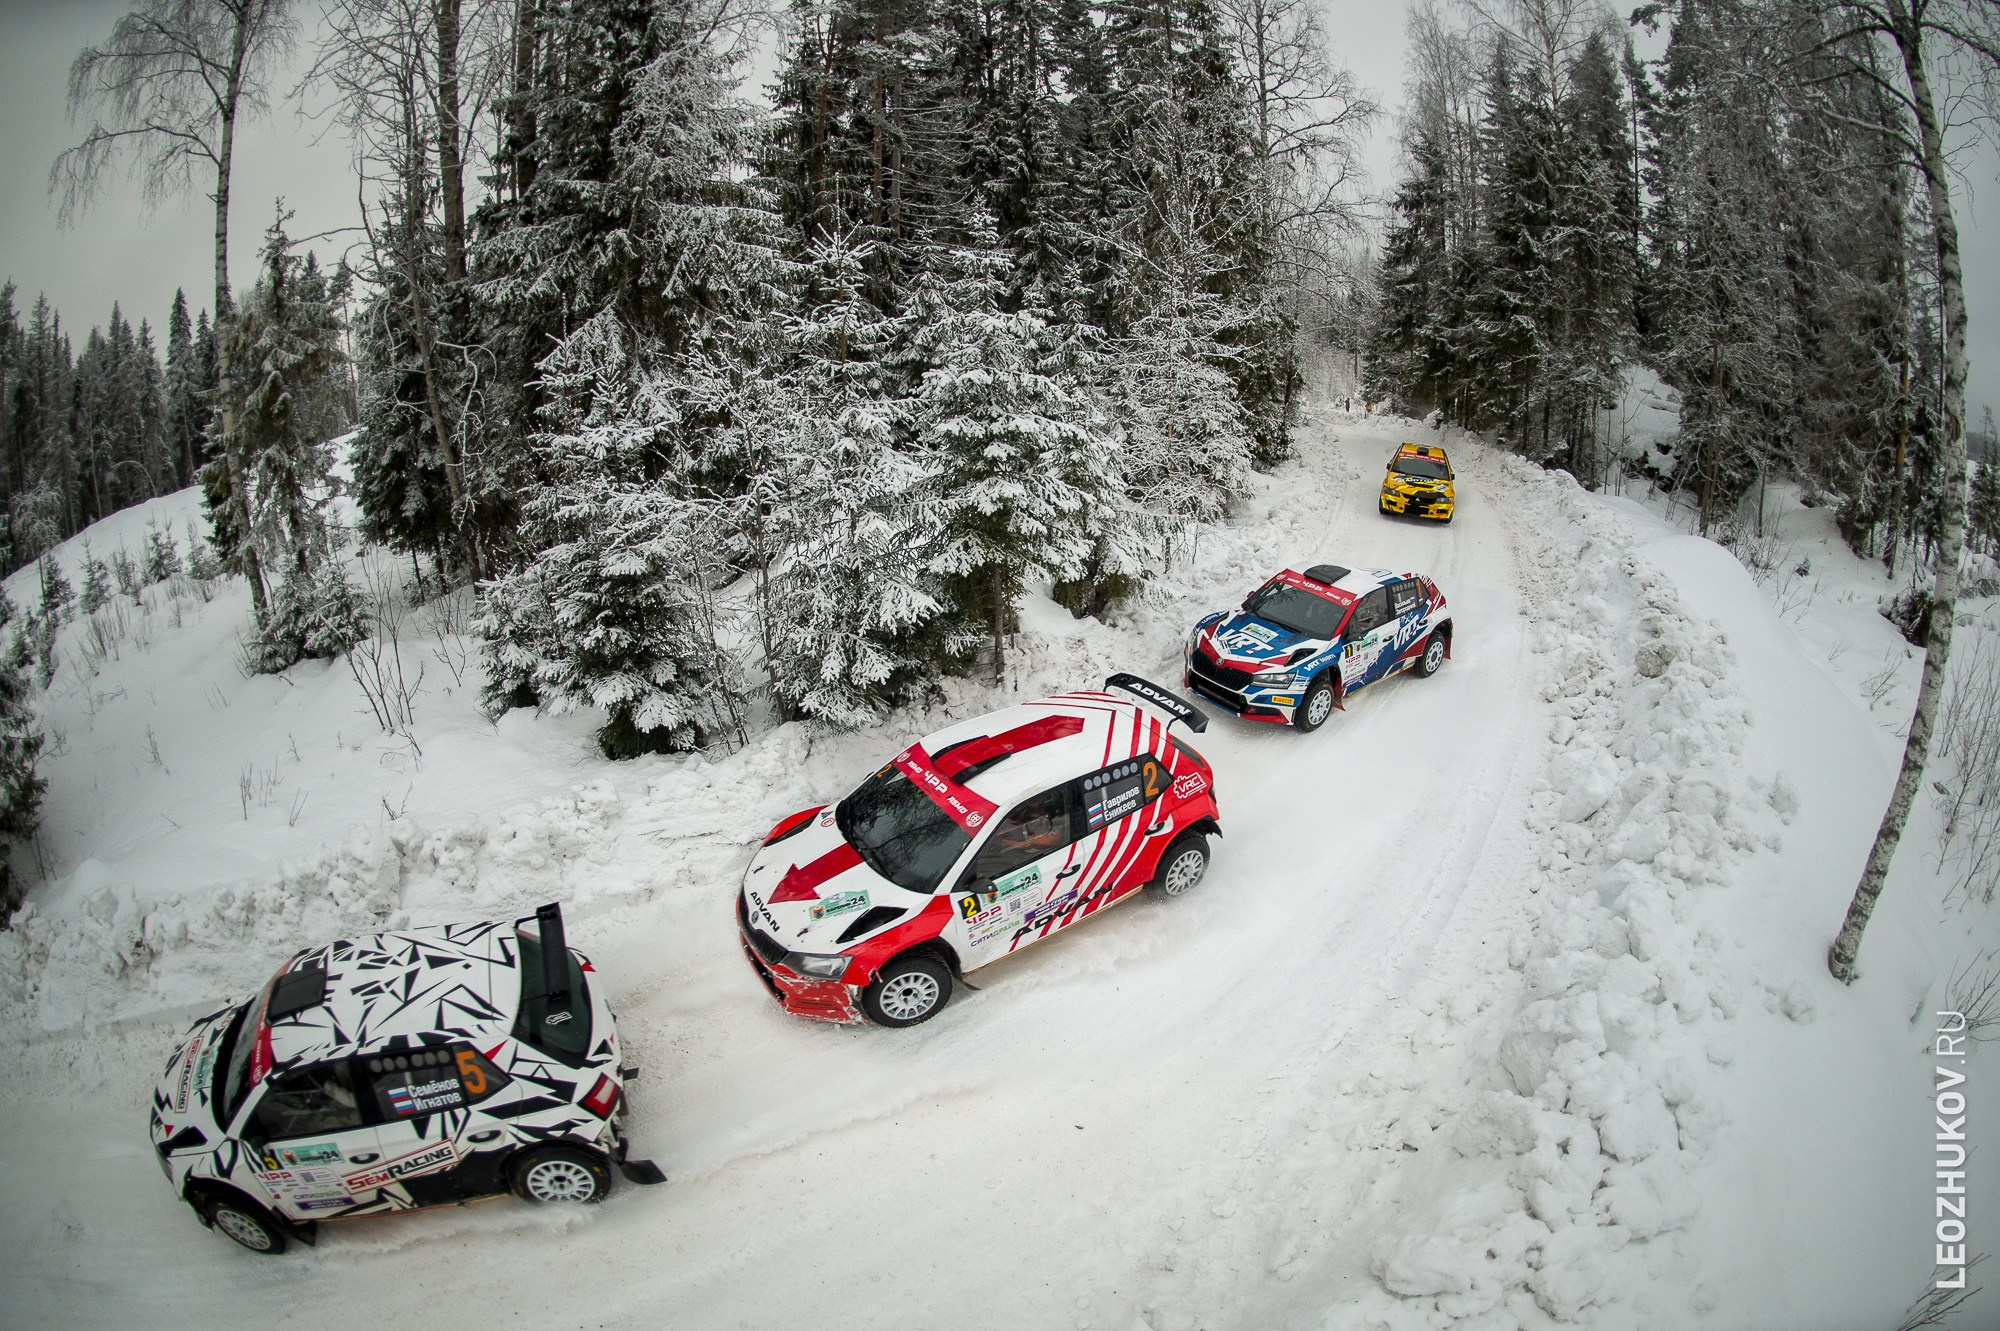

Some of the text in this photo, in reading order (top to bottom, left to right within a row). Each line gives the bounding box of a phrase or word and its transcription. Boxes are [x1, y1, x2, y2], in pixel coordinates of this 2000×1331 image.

[1218, 628, 1275, 652] VRT
[1304, 659, 1320, 672] VRT
[1128, 682, 1192, 716] ADVAN
[1143, 761, 1160, 797] 2
[1102, 786, 1140, 811] Гаврилов
[1103, 799, 1137, 822] Еникеев
[750, 890, 781, 933] ADVAN
[963, 897, 977, 918] 2
[1010, 883, 1114, 942] ADVAN
[456, 1050, 487, 1094] 5
[408, 1078, 460, 1097] Семёнов
[413, 1092, 462, 1110] Игнатов
